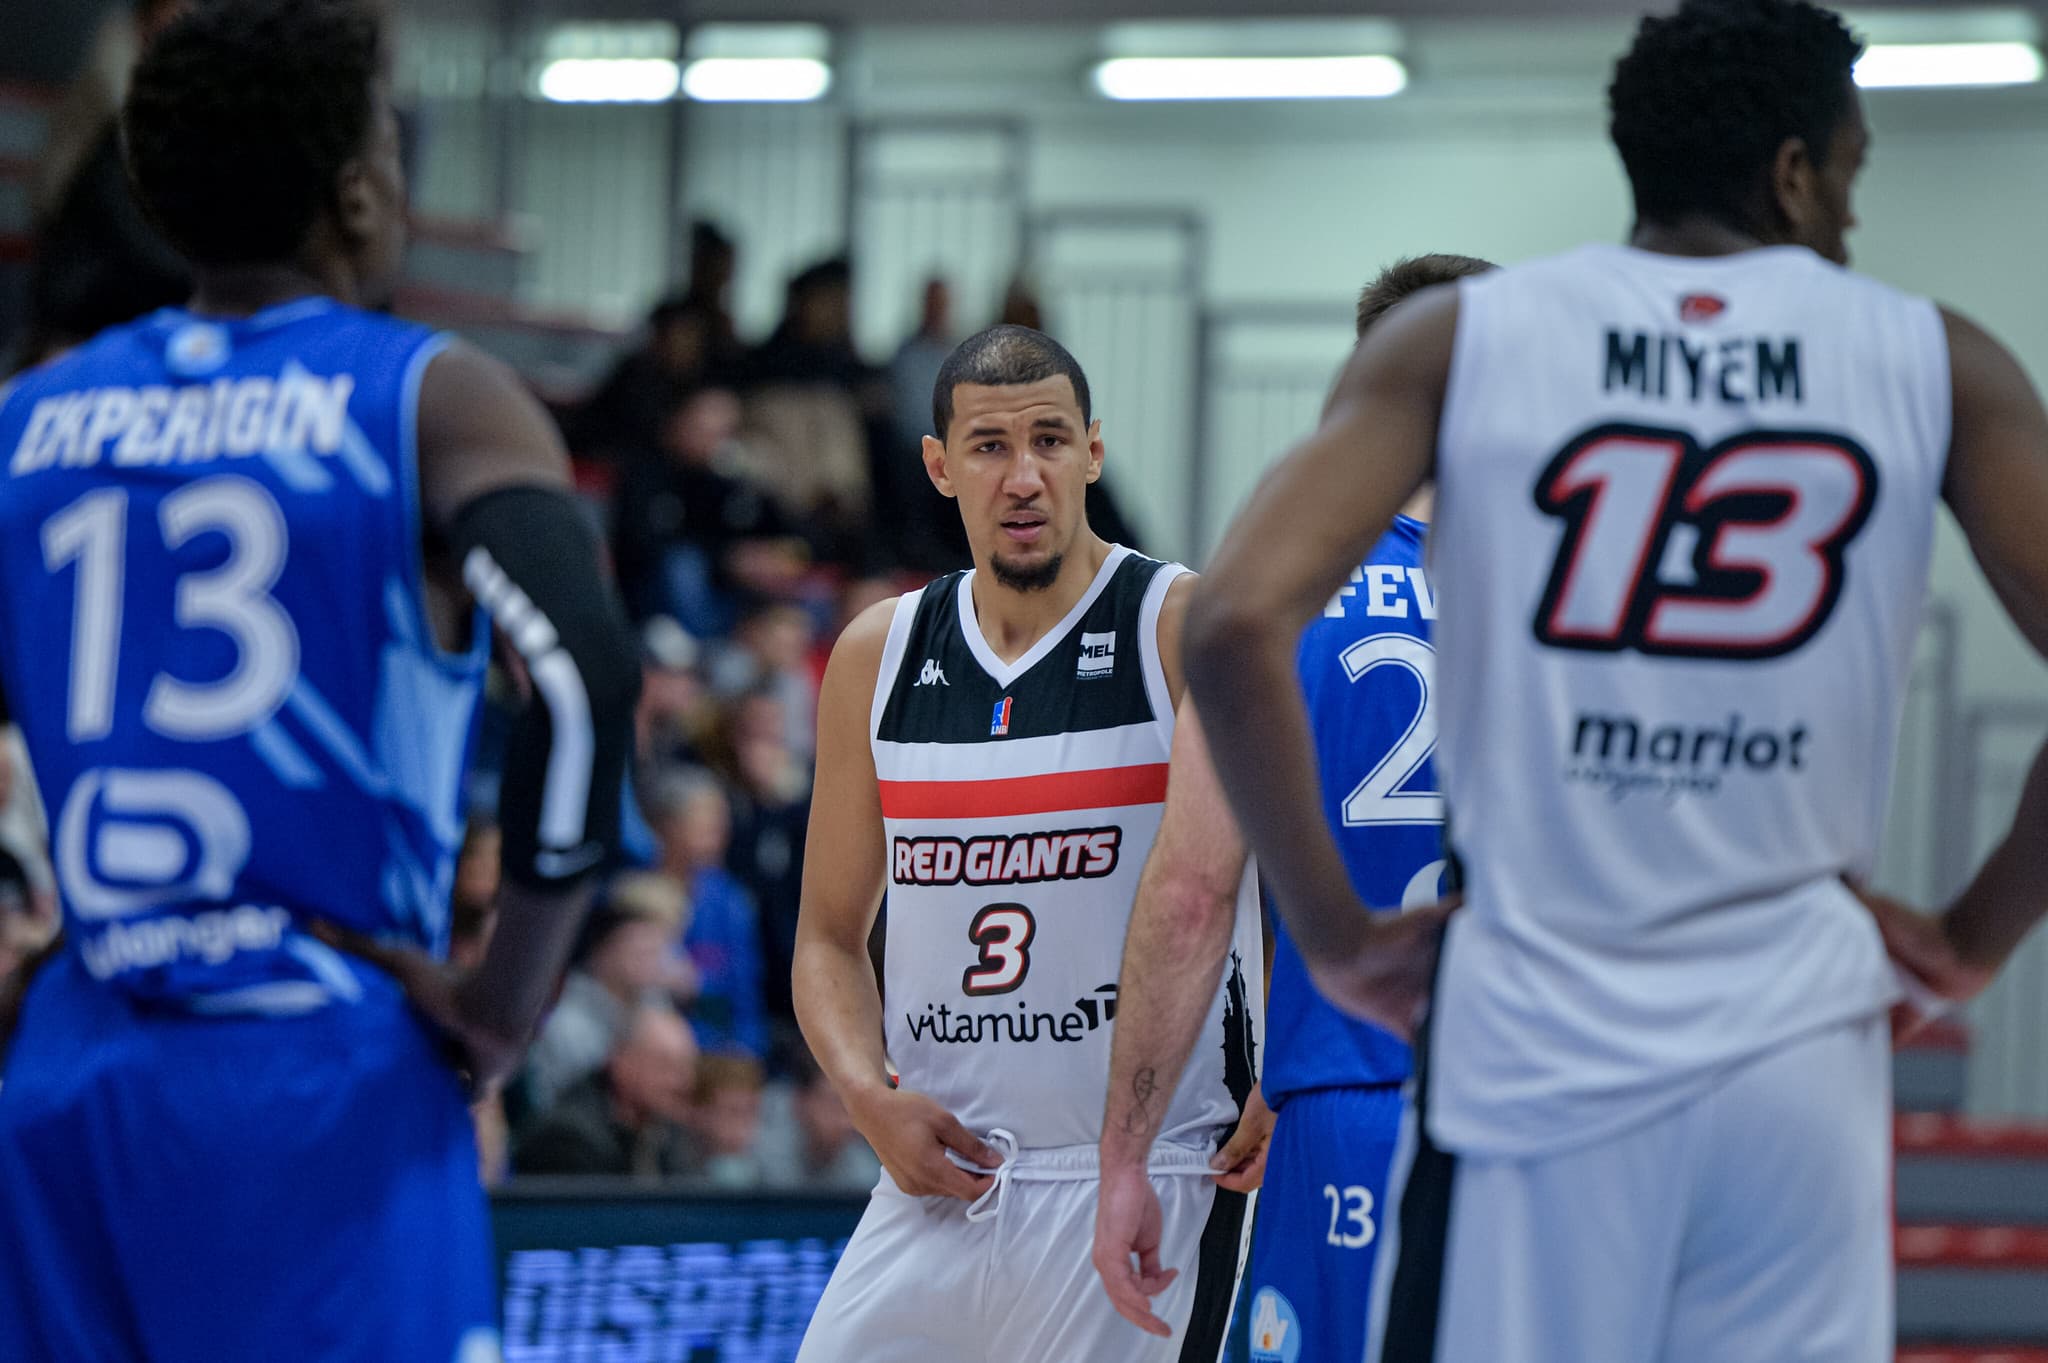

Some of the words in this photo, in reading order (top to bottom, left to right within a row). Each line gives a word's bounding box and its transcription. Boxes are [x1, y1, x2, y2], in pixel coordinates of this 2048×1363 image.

[1604, 328, 1805, 405] MIYEM
[1533, 423, 1880, 661] 13
[41, 476, 300, 742] 13
[1080, 643, 1115, 659] MEL
[962, 903, 1036, 996] 3
[1323, 1183, 1376, 1249] 23
